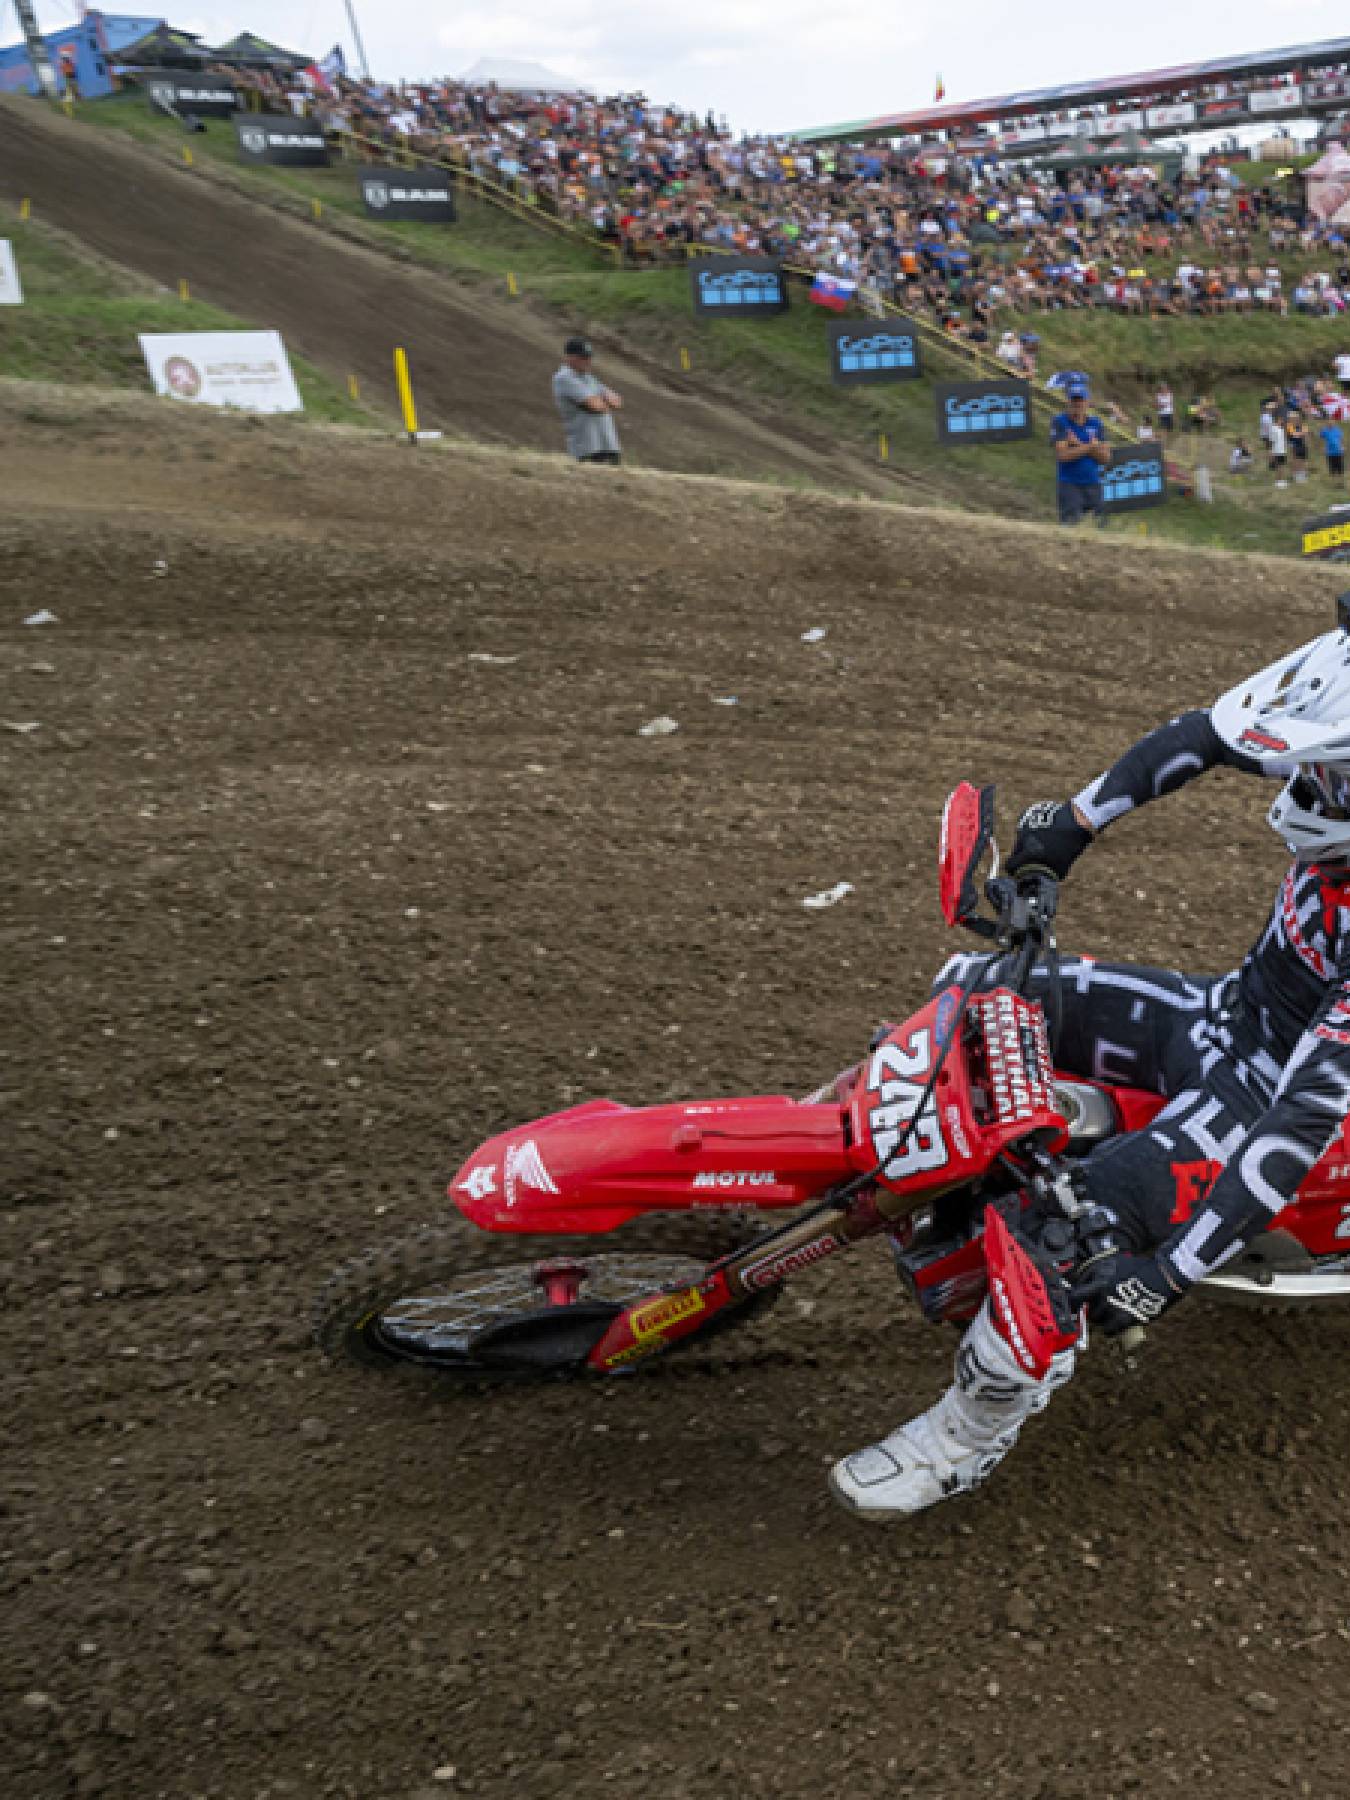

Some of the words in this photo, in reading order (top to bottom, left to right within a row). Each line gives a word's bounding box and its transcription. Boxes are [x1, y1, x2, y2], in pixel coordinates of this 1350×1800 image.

[698, 269, 779, 289] GoPro
[837, 335, 913, 353] GoPro
[945, 393, 1025, 415] GoPro
[867, 1028, 949, 1181] 243
[692, 1171, 776, 1189] MOTUL
